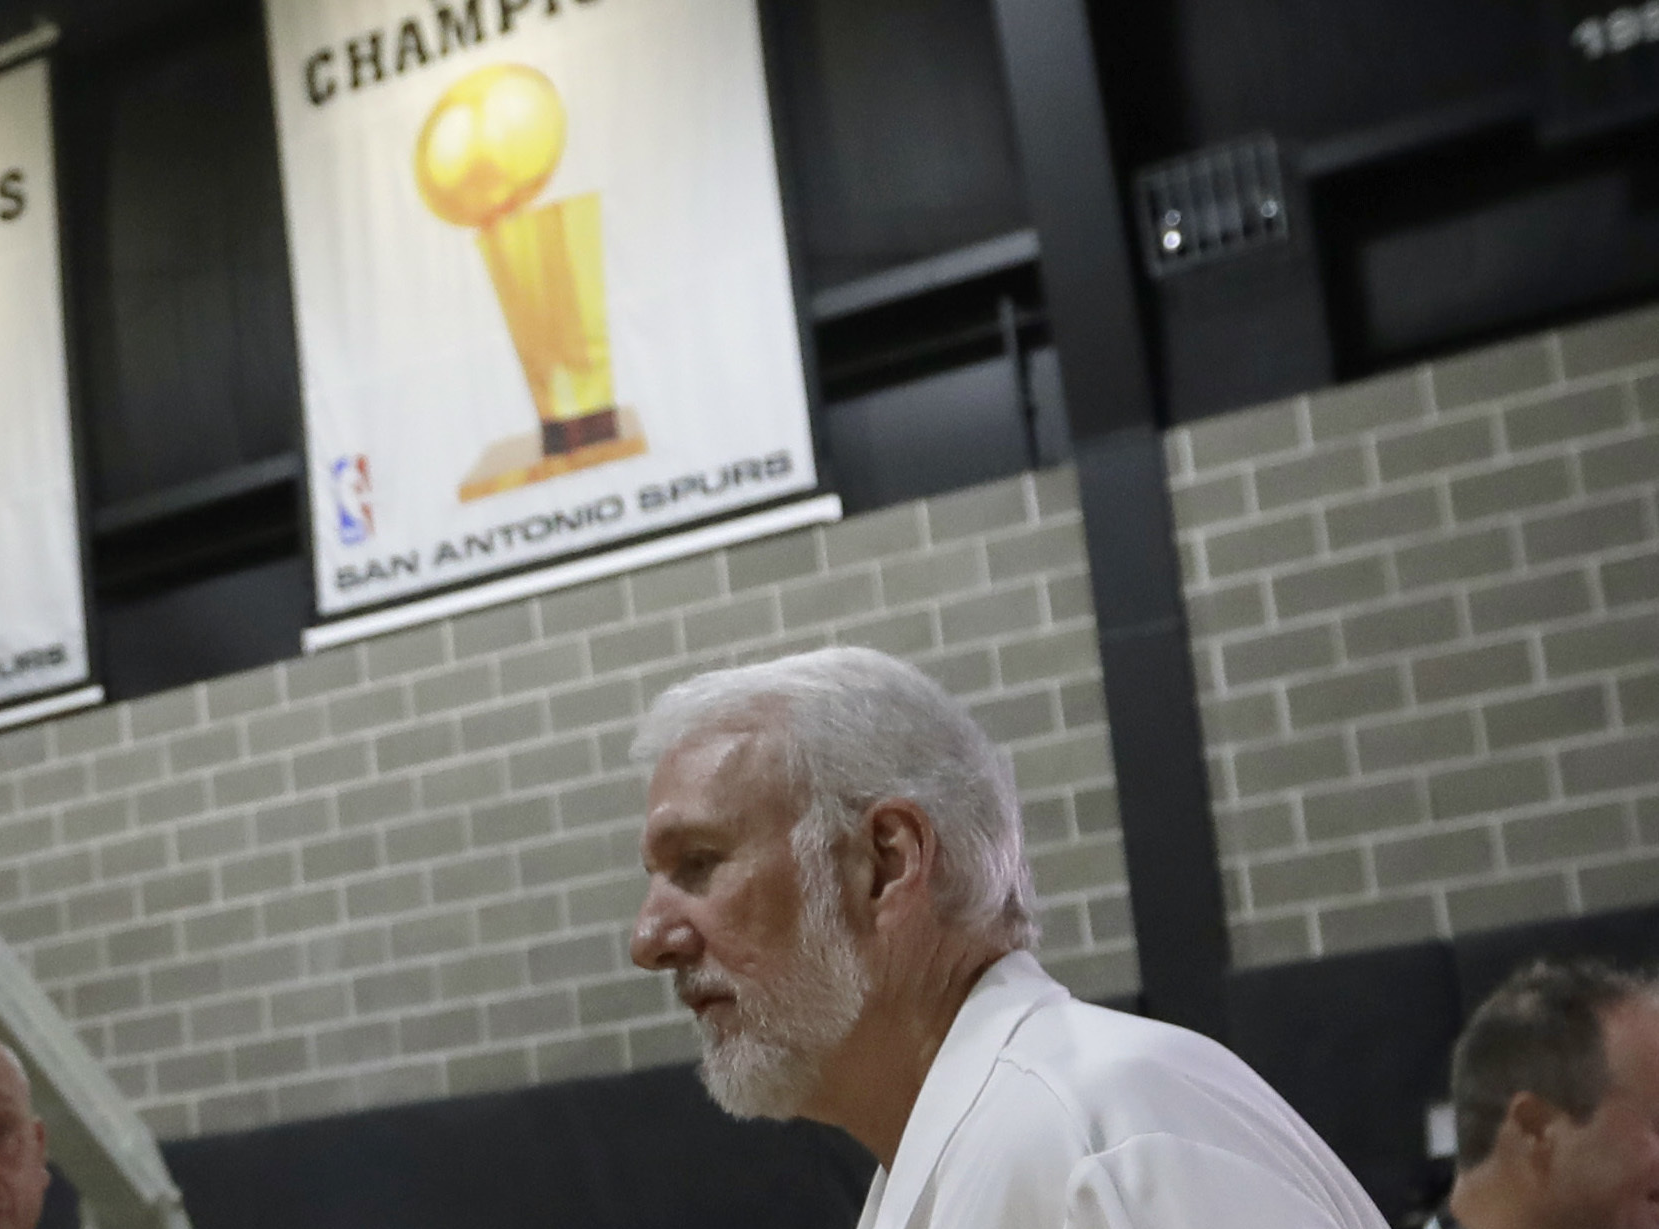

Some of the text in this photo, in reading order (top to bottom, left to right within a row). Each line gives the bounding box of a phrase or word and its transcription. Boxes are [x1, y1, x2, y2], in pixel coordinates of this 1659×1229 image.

[336, 448, 793, 590] SAN ANTONIO SPURS
